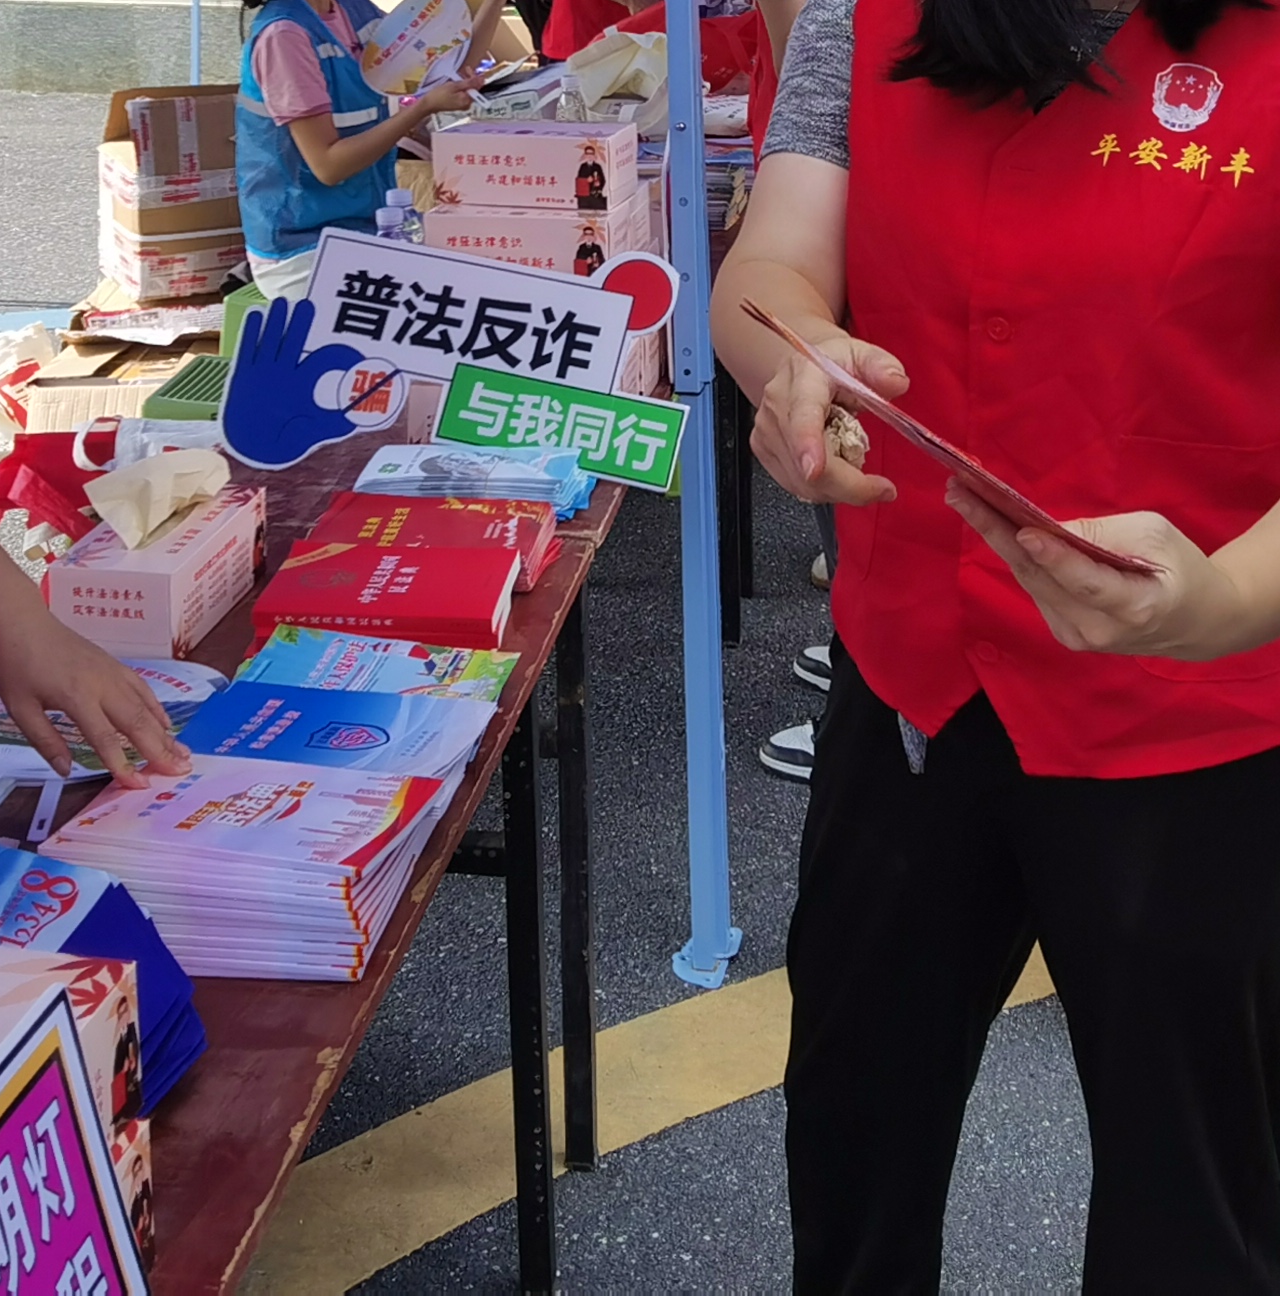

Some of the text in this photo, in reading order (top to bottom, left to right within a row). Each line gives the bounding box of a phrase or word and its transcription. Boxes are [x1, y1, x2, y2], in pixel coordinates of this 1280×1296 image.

[485, 173, 559, 187] 共建和谐新丰
[1090, 133, 1255, 189] 平安新丰
[331, 267, 602, 380] 普法反诈
[456, 380, 672, 472] 与我同行
[357, 555, 402, 604] 中华人民共和国
